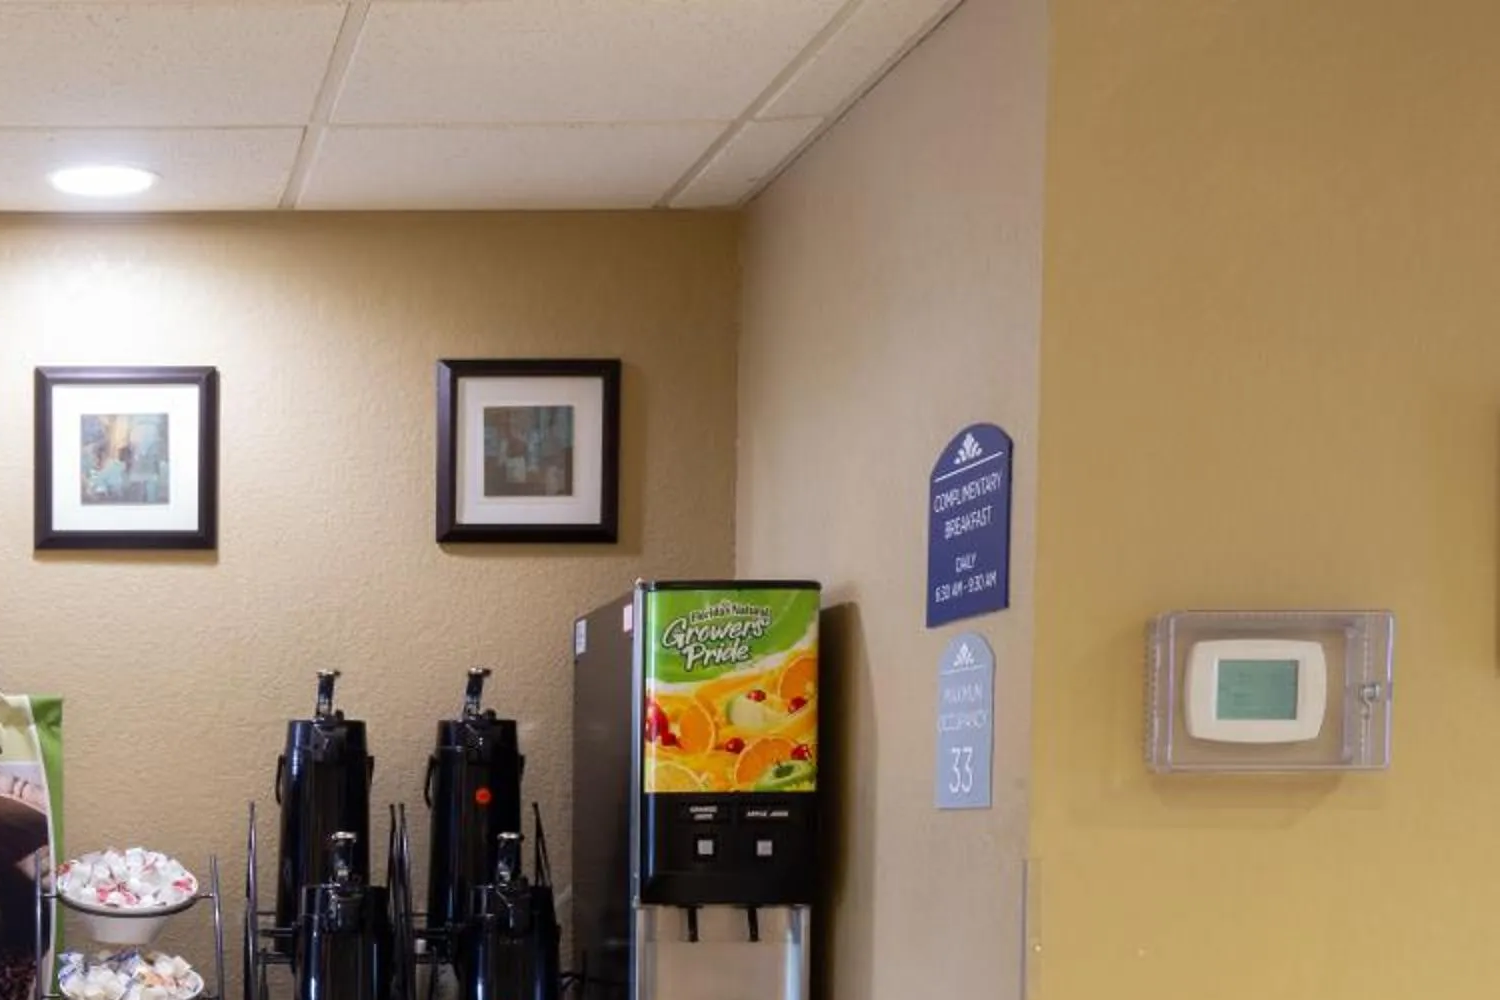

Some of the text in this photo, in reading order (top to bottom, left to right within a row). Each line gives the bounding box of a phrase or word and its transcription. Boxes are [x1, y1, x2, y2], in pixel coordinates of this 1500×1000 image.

[933, 469, 1003, 513] COMPLIMENTARY
[944, 504, 994, 540] BREAKFAST
[681, 637, 751, 671] Pride
[949, 746, 974, 793] 33
